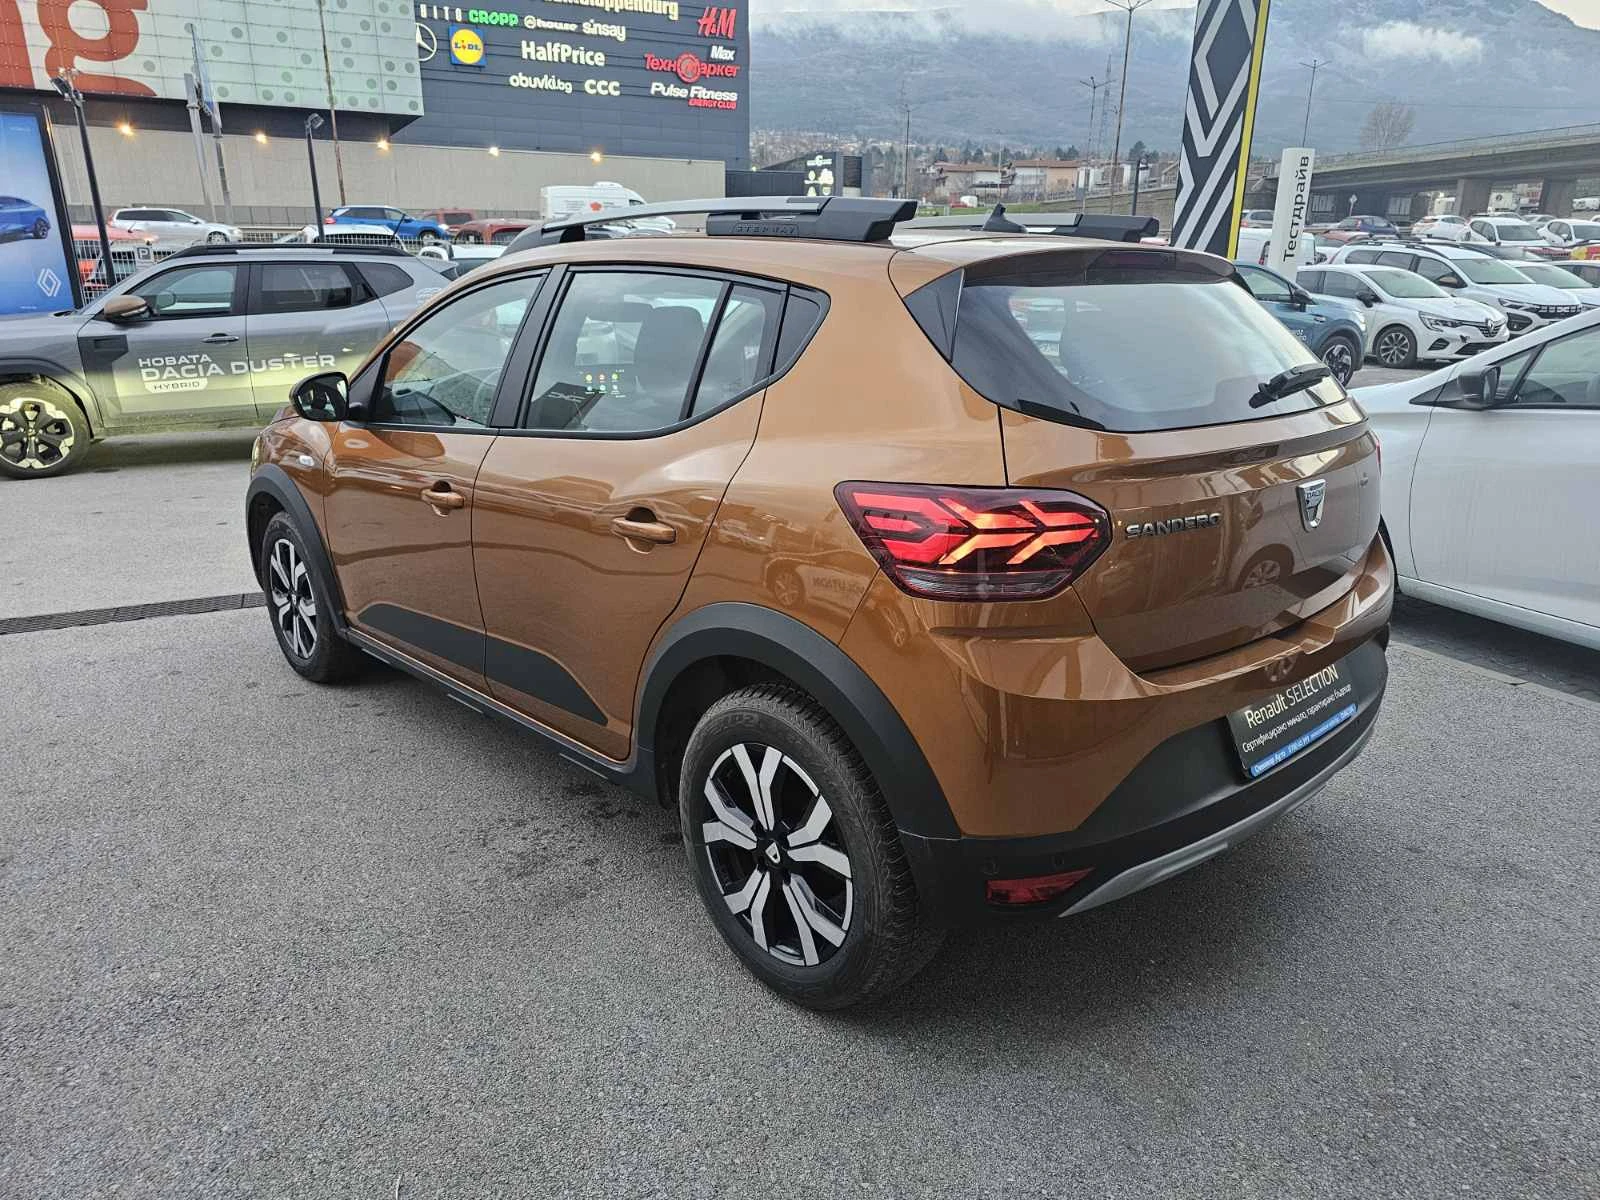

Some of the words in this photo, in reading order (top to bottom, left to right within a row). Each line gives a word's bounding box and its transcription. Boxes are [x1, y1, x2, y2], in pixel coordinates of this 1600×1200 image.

[468, 9, 519, 27] CROPP
[697, 7, 737, 39] H&M
[582, 18, 626, 42] sinsay
[521, 40, 606, 67] HalfPrice
[710, 45, 735, 61] Max
[509, 72, 573, 94] obuvki.bg
[584, 79, 621, 96] CCC
[650, 82, 689, 98] Pulse
[690, 86, 738, 101] Fitness
[1283, 155, 1309, 262] Тестдрайв
[138, 354, 213, 367] НОВАТА
[141, 363, 225, 381] DACIA
[230, 354, 336, 375] DUSTER
[154, 381, 200, 390] HYBRID
[1126, 512, 1222, 539] SANDERO
[1244, 694, 1289, 729] Renault
[1286, 663, 1339, 706] SELECTION
